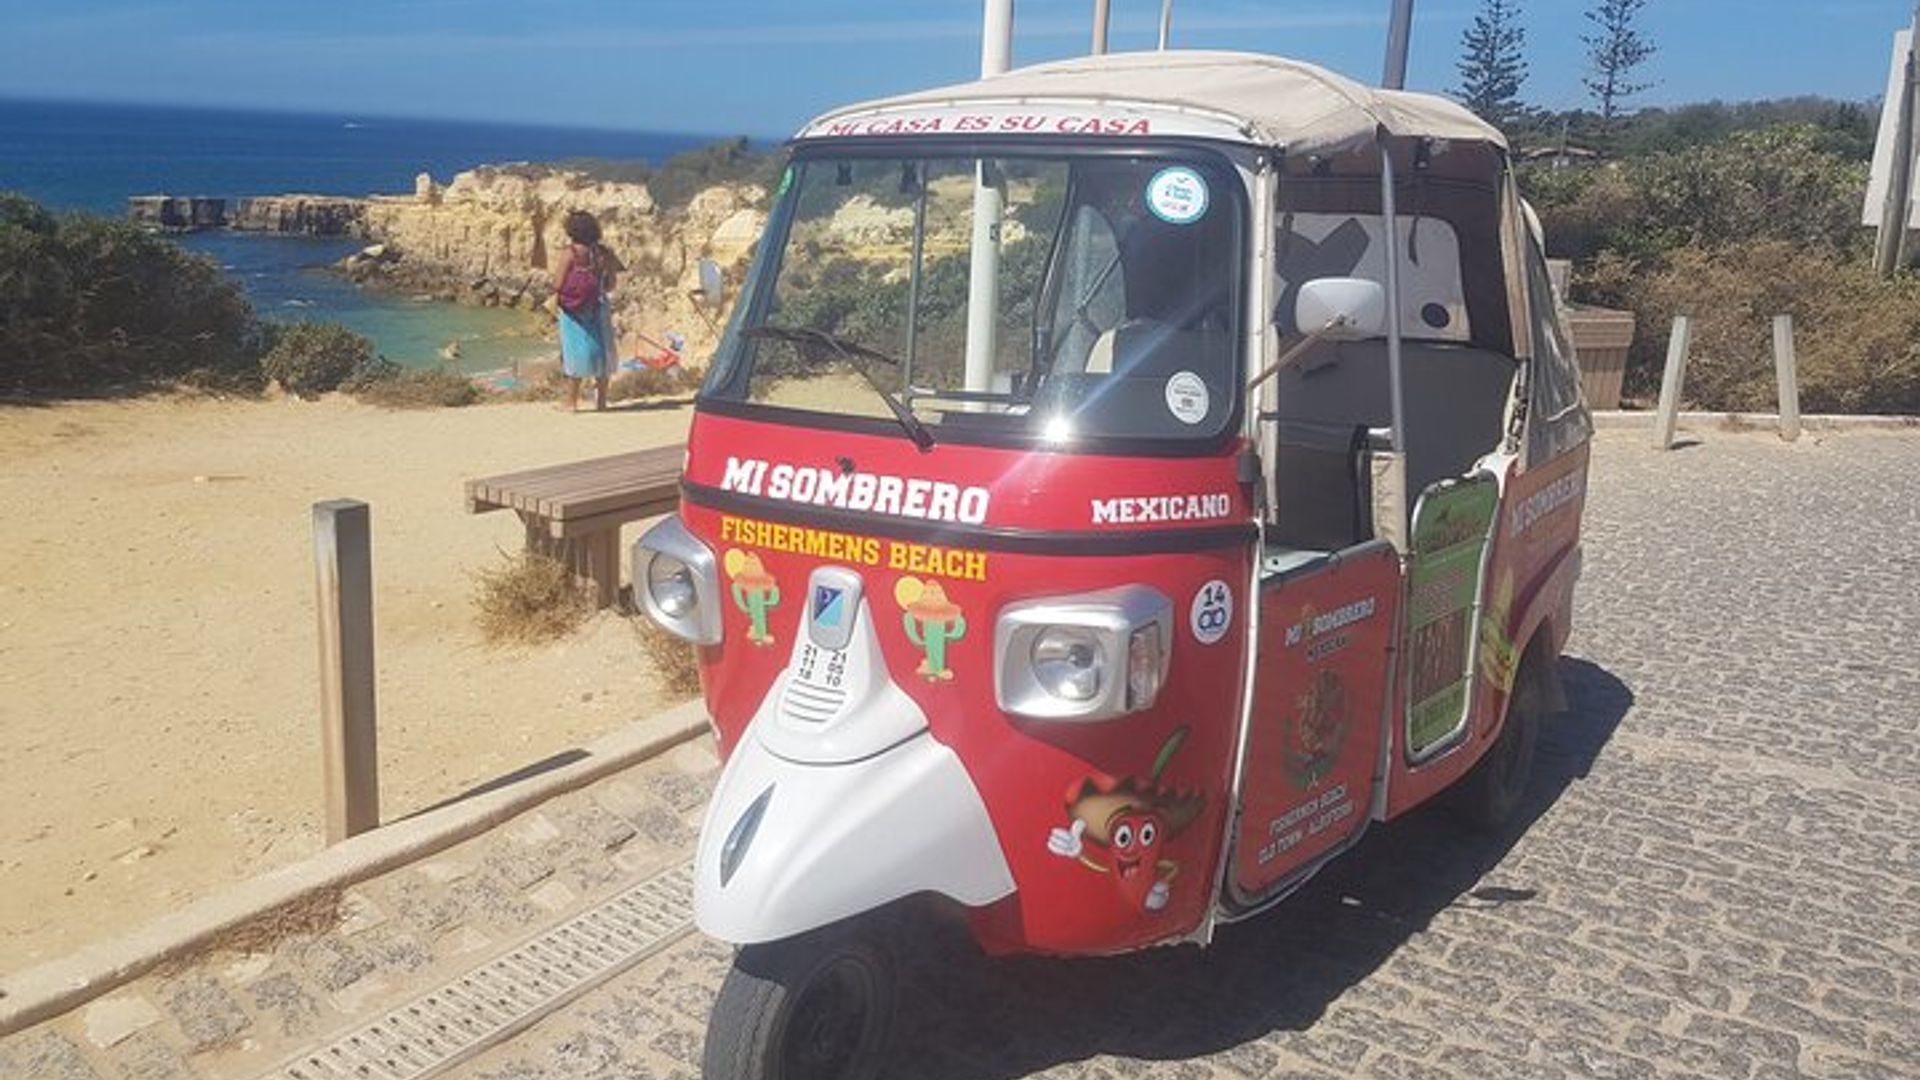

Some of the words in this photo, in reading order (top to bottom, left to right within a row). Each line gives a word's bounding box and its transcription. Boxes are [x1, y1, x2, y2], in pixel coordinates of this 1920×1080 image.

[827, 122, 856, 136] MI
[867, 117, 942, 136] CASA
[953, 116, 991, 131] ES
[999, 116, 1045, 132] SU
[1057, 117, 1151, 135] CASA
[720, 456, 769, 496] MI
[767, 463, 991, 525] SOMBRERO
[1090, 493, 1231, 524] MEXICANO
[721, 515, 880, 566] FISHERMENS
[888, 542, 987, 581] BEACH
[1203, 584, 1226, 608] 14
